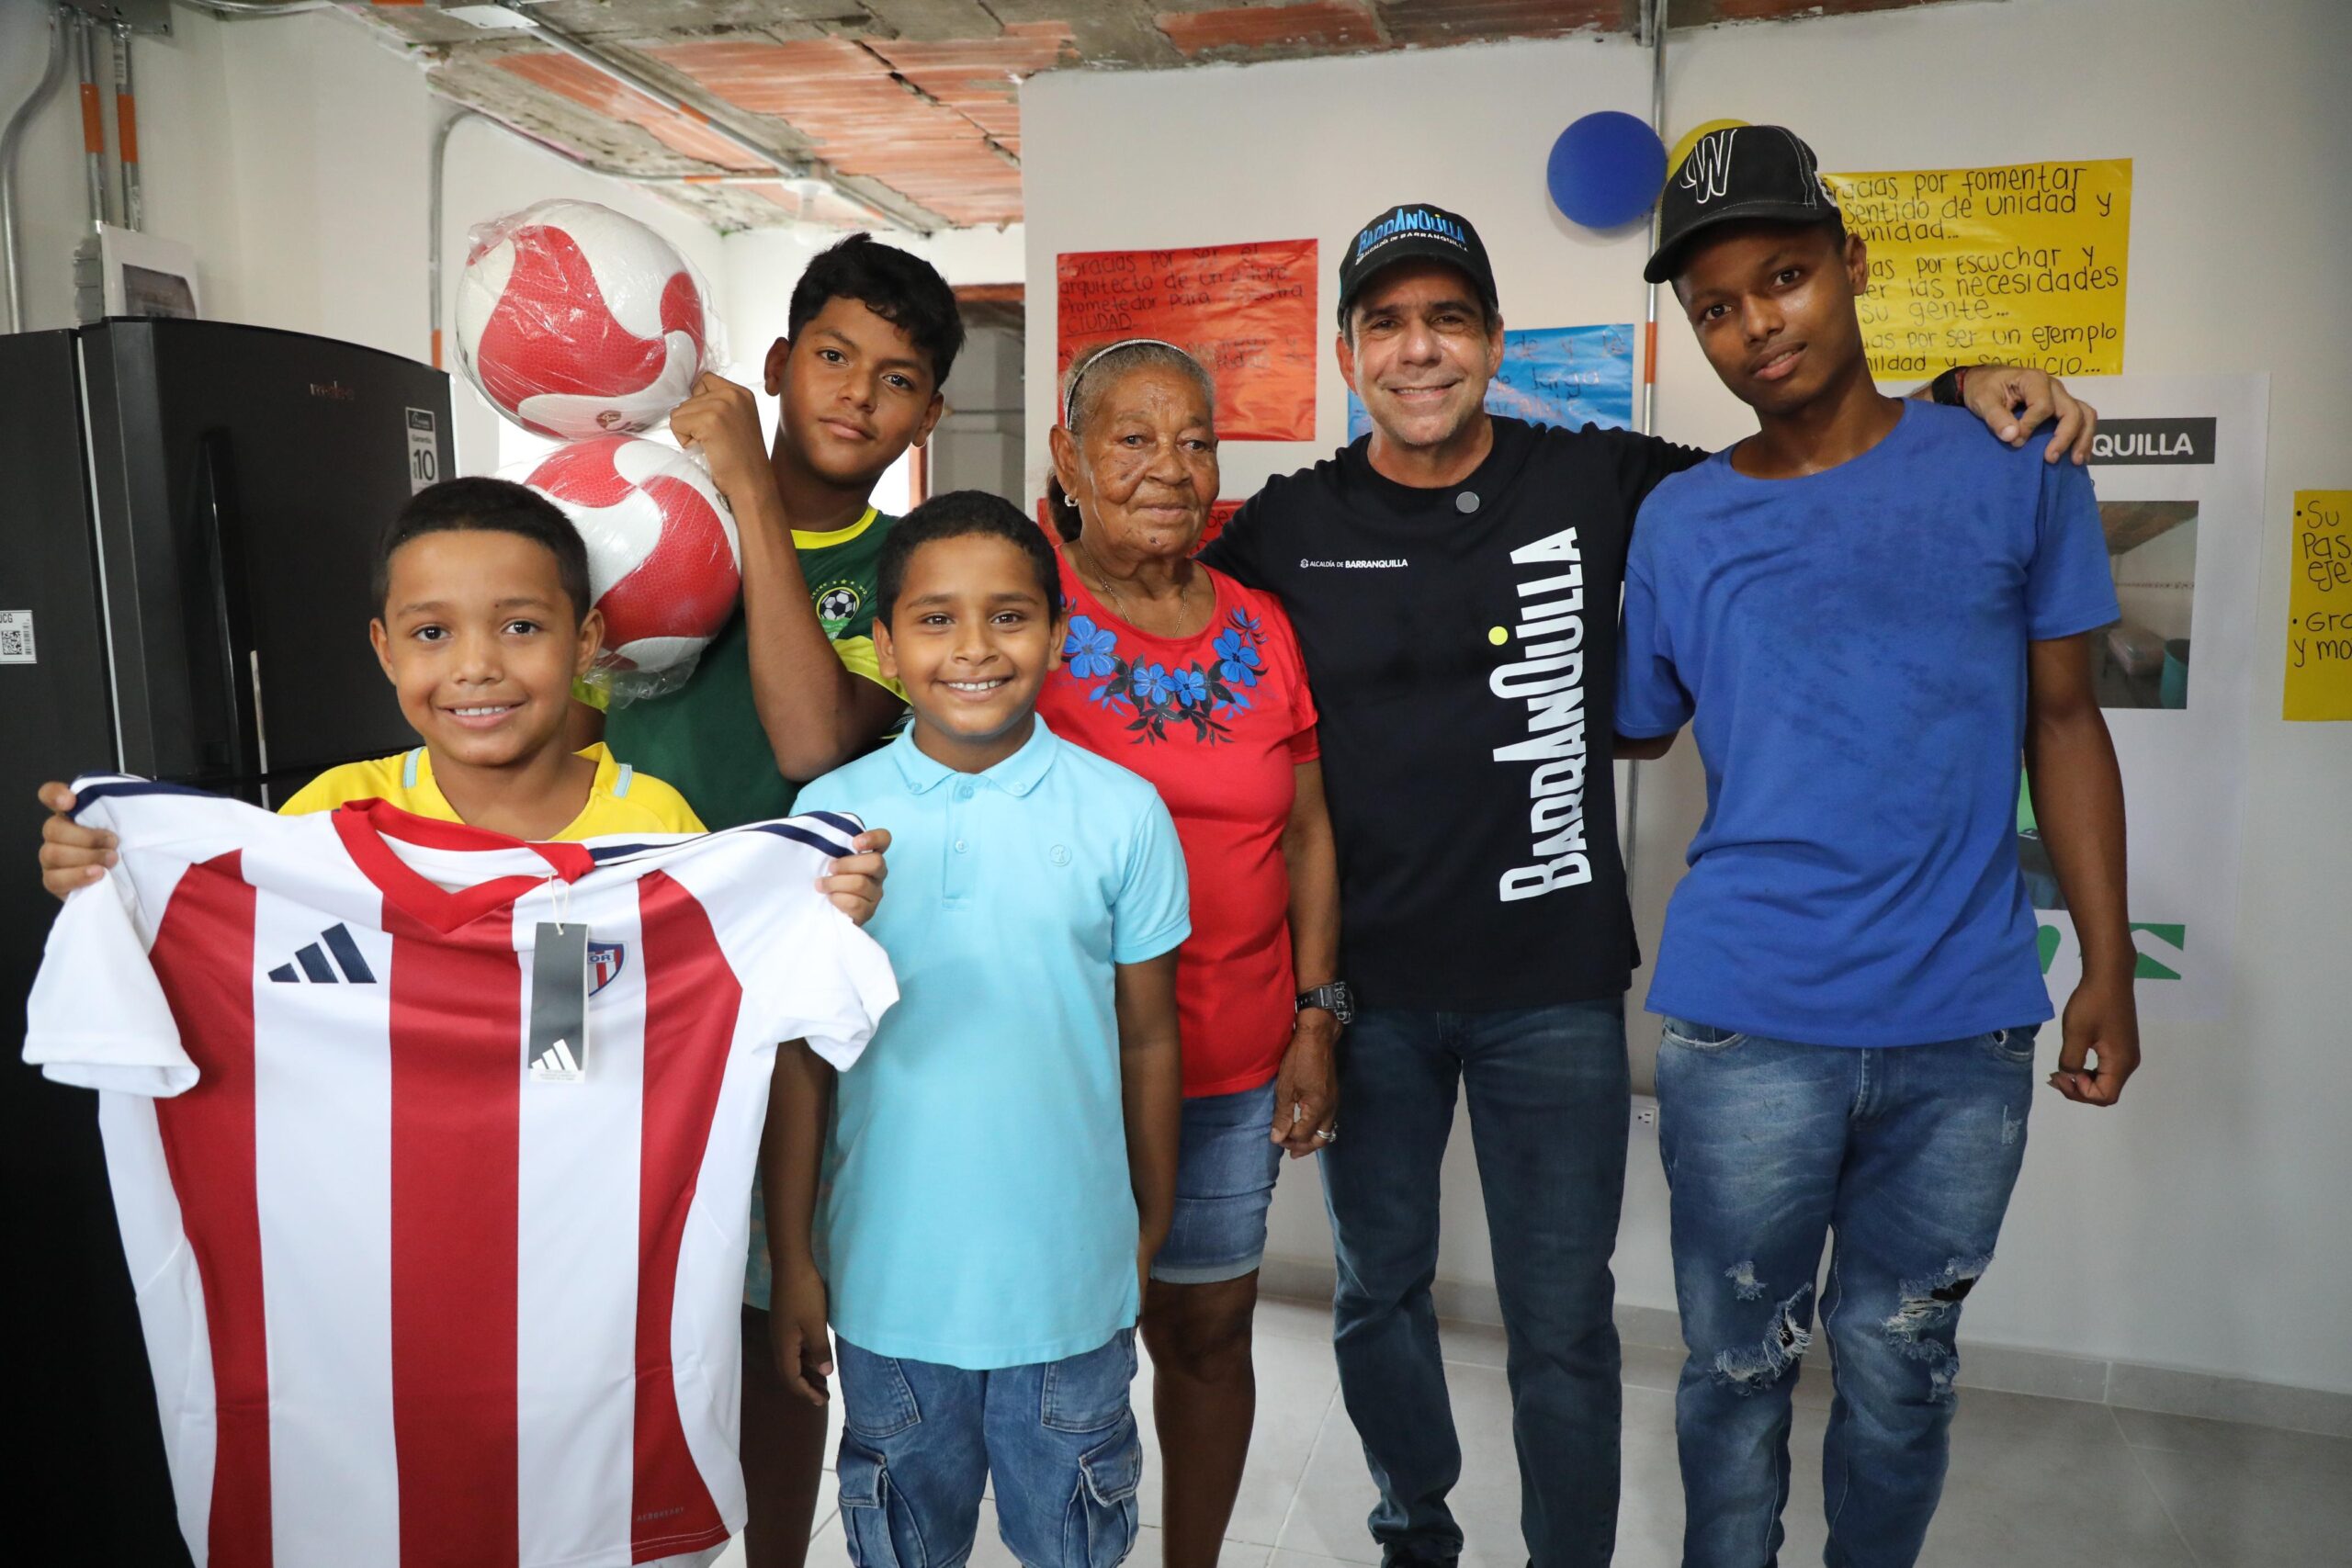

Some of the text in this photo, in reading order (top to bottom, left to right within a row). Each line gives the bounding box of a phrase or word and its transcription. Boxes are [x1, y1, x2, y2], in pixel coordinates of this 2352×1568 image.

[1822, 165, 2086, 200] racias por fomentar
[1941, 196, 1972, 220] de
[2098, 192, 2112, 217] y
[1847, 219, 1960, 243] unidad...
[1917, 257, 1947, 278] por
[1908, 277, 1945, 299] las
[1957, 265, 2120, 299] necesidades
[1907, 332, 1937, 348] por
[1946, 329, 1976, 349] ser
[1993, 328, 2020, 345] un
[413, 449, 435, 481] 10
[1344, 558, 1409, 569] BARRANQUILLA
[2293, 637, 2307, 668] y
